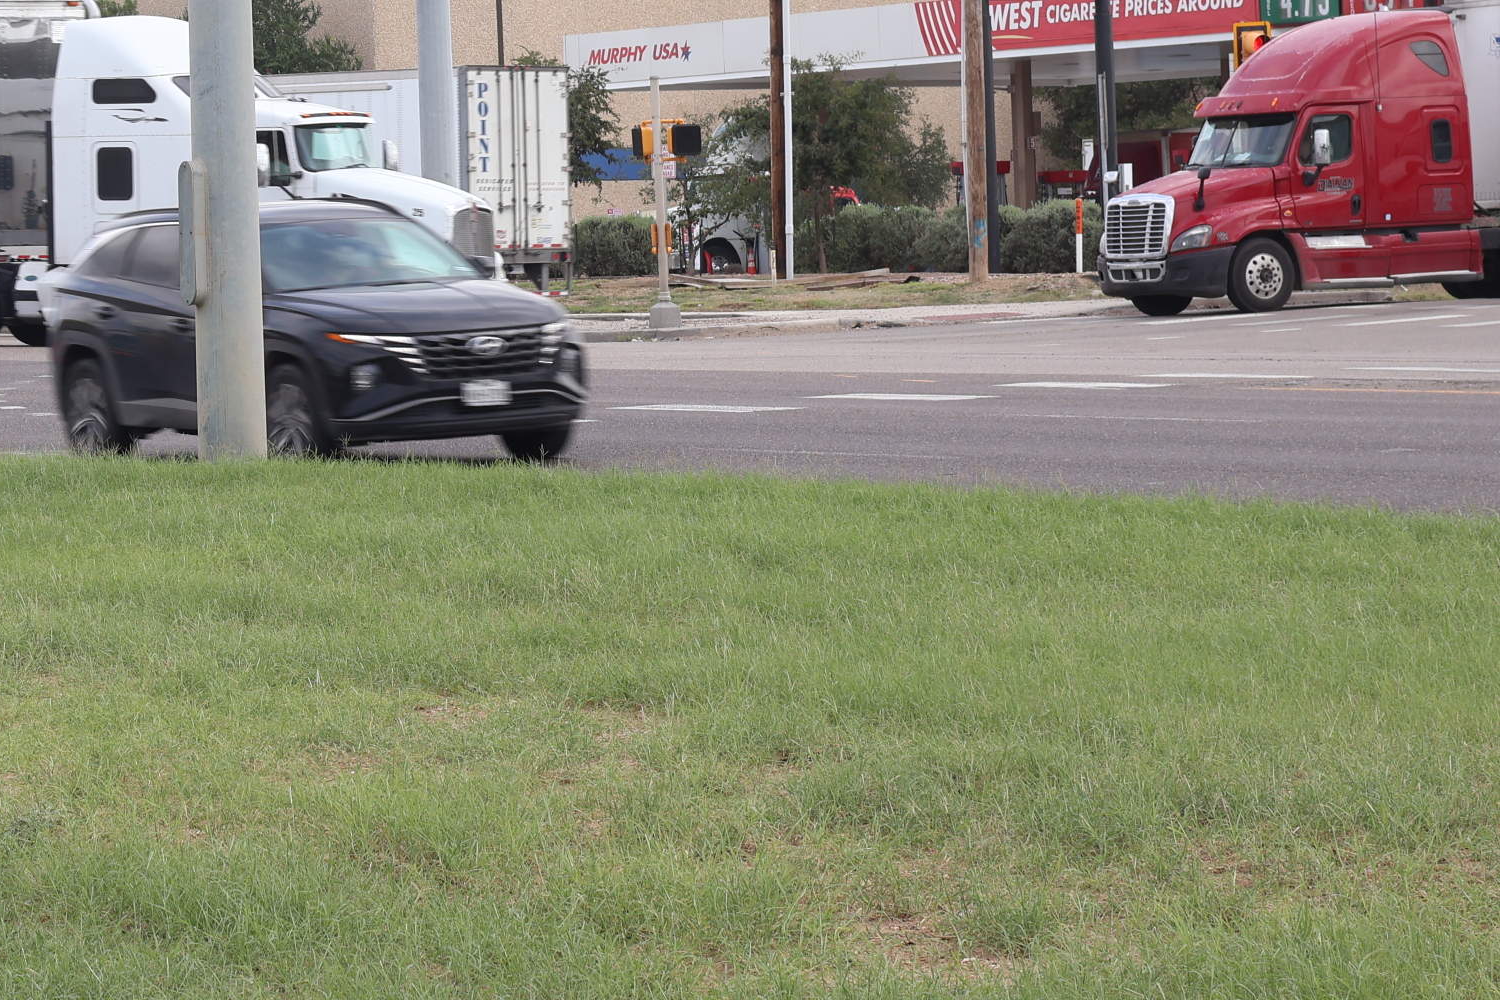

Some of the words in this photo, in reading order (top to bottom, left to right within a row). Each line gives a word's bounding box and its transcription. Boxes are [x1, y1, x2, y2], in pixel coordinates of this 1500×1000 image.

[989, 0, 1043, 31] WEST
[1046, 0, 1120, 25] CIGAREE
[588, 45, 647, 66] MURPHY
[652, 43, 680, 61] USA
[477, 82, 491, 173] POINT
